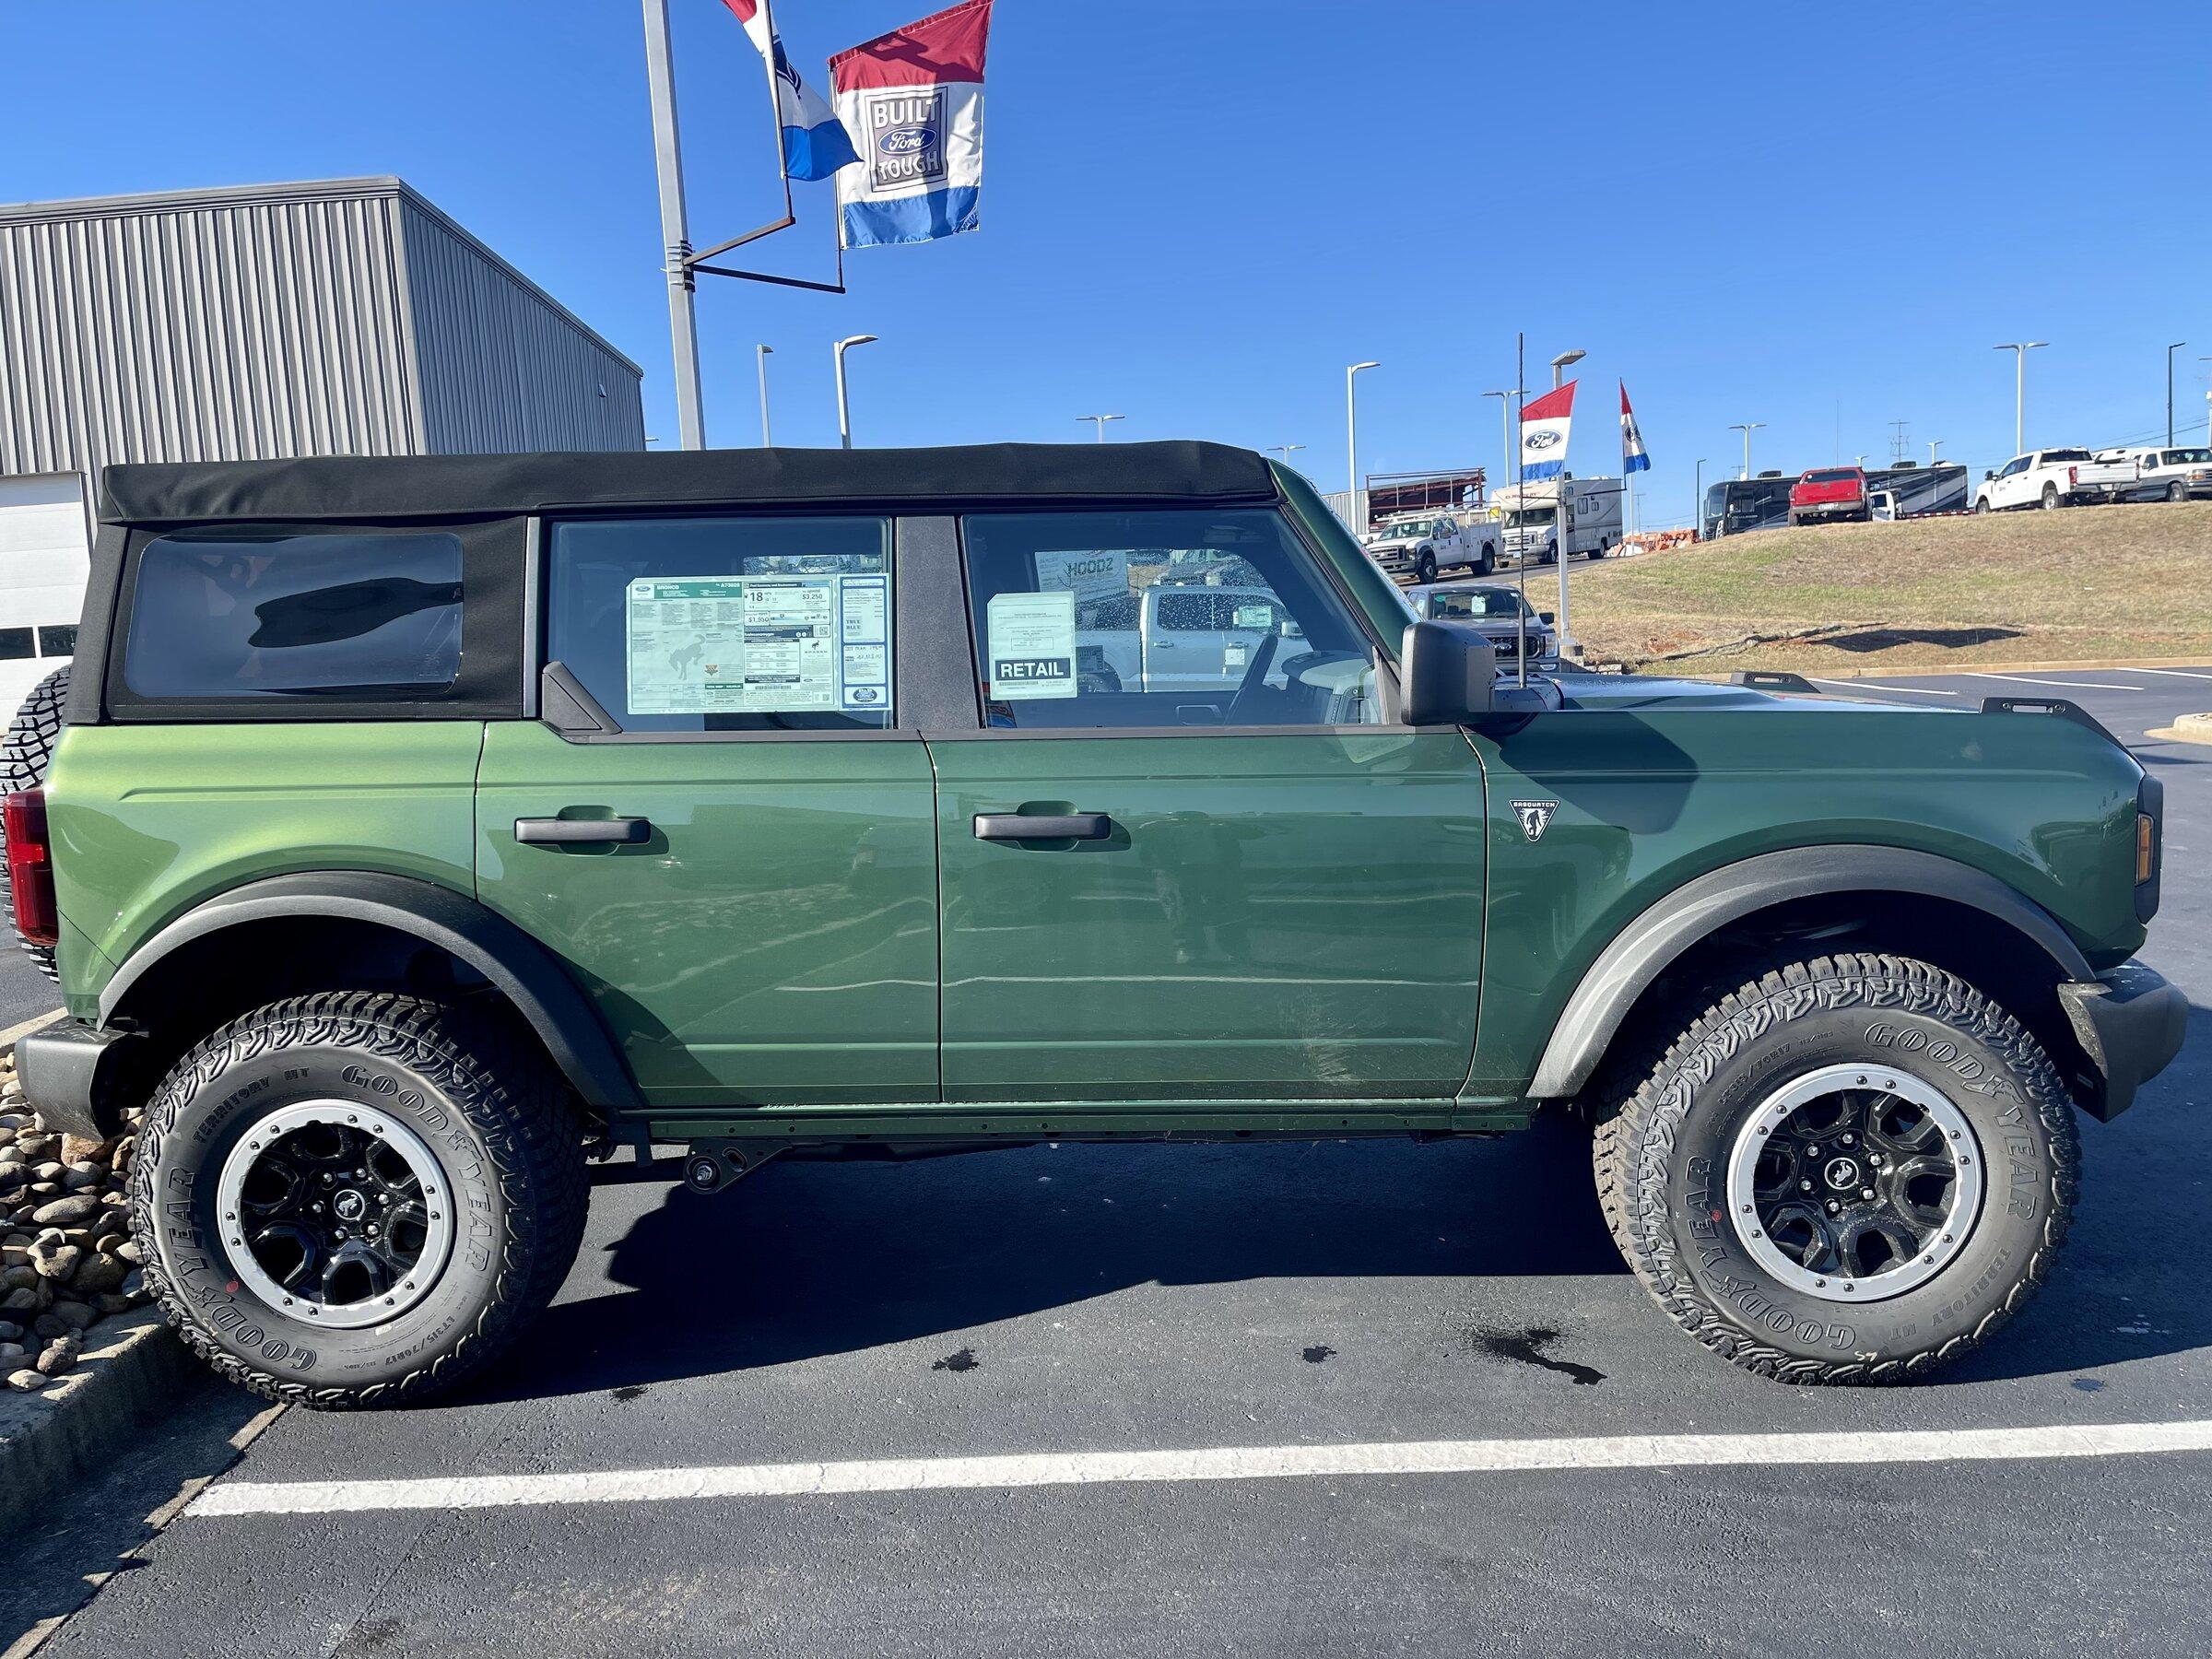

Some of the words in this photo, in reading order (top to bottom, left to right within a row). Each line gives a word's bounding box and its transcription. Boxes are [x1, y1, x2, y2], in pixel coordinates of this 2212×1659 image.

[875, 96, 939, 129] BUILT
[888, 129, 925, 151] Ford
[877, 151, 940, 181] TOUGH
[749, 592, 763, 602] 18
[1000, 661, 1064, 677] RETAIL
[192, 1076, 270, 1144] TERRITORY
[1932, 1246, 2012, 1327] TERRITORY
